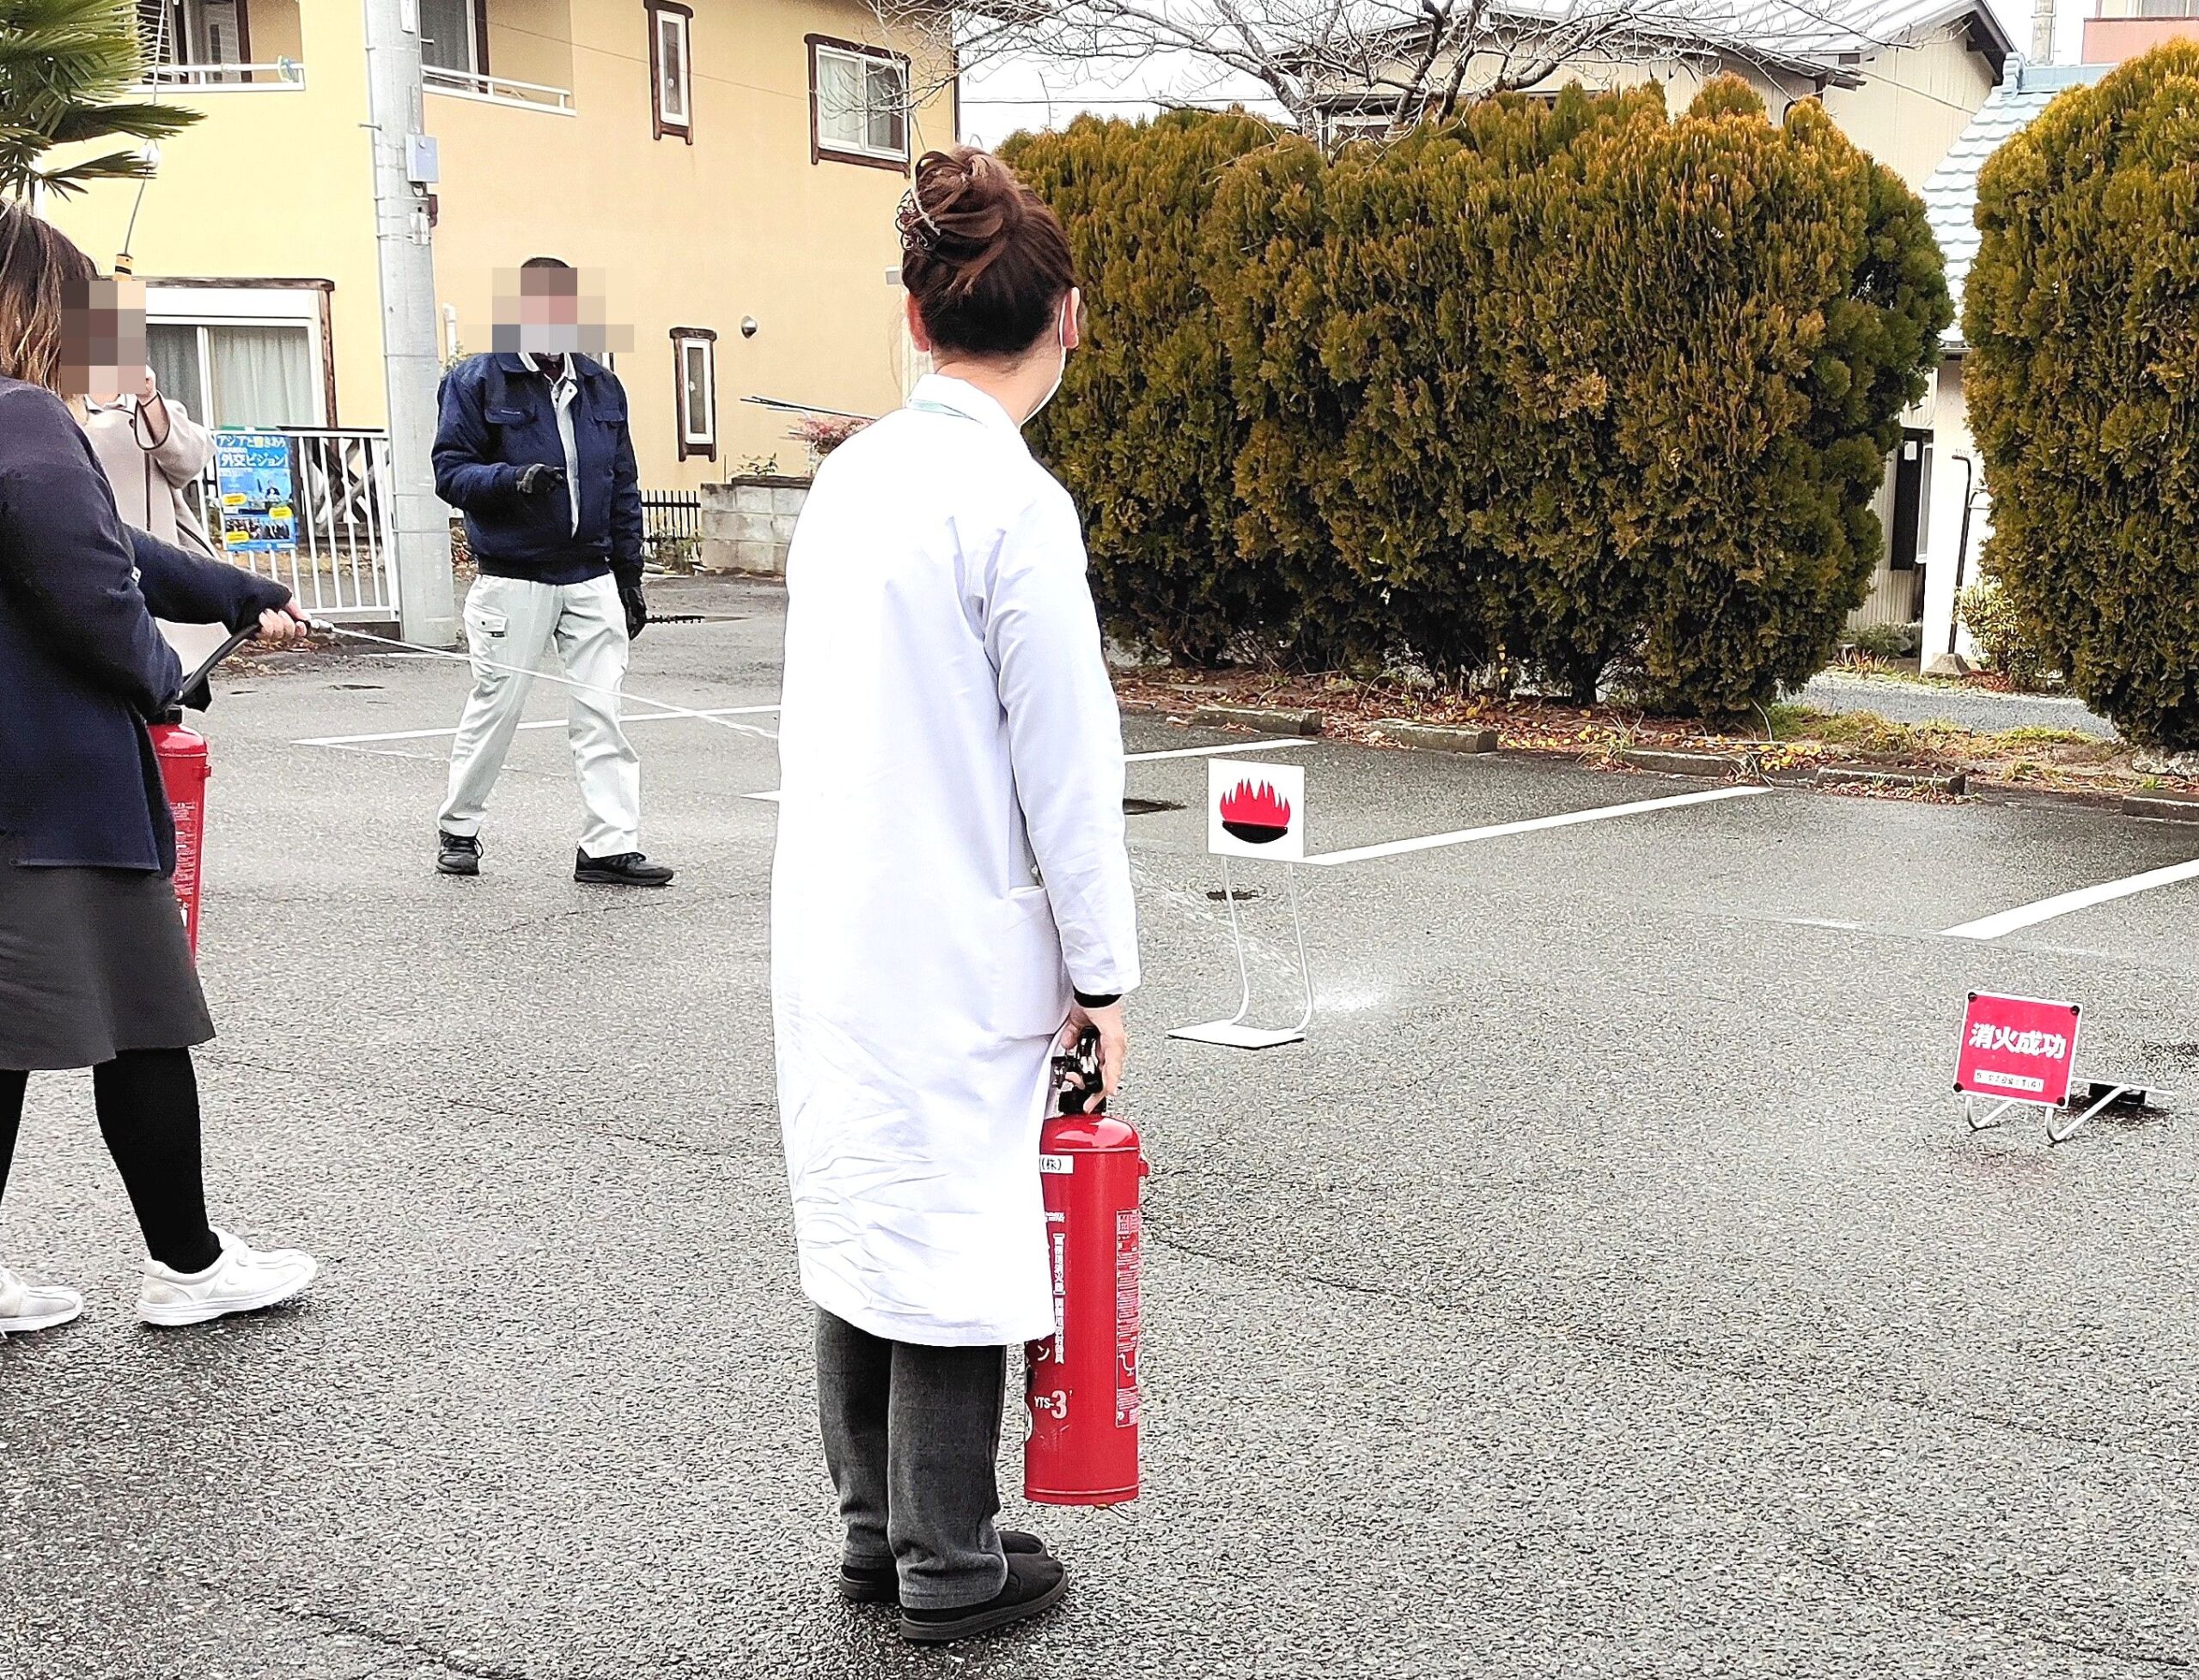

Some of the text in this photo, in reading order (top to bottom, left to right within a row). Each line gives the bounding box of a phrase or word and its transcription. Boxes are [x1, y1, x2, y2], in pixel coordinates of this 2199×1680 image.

[221, 452, 285, 467] 外交ビジョン
[1968, 1022, 2067, 1059] 消火成功
[1034, 1390, 1067, 1420] YTS-3
